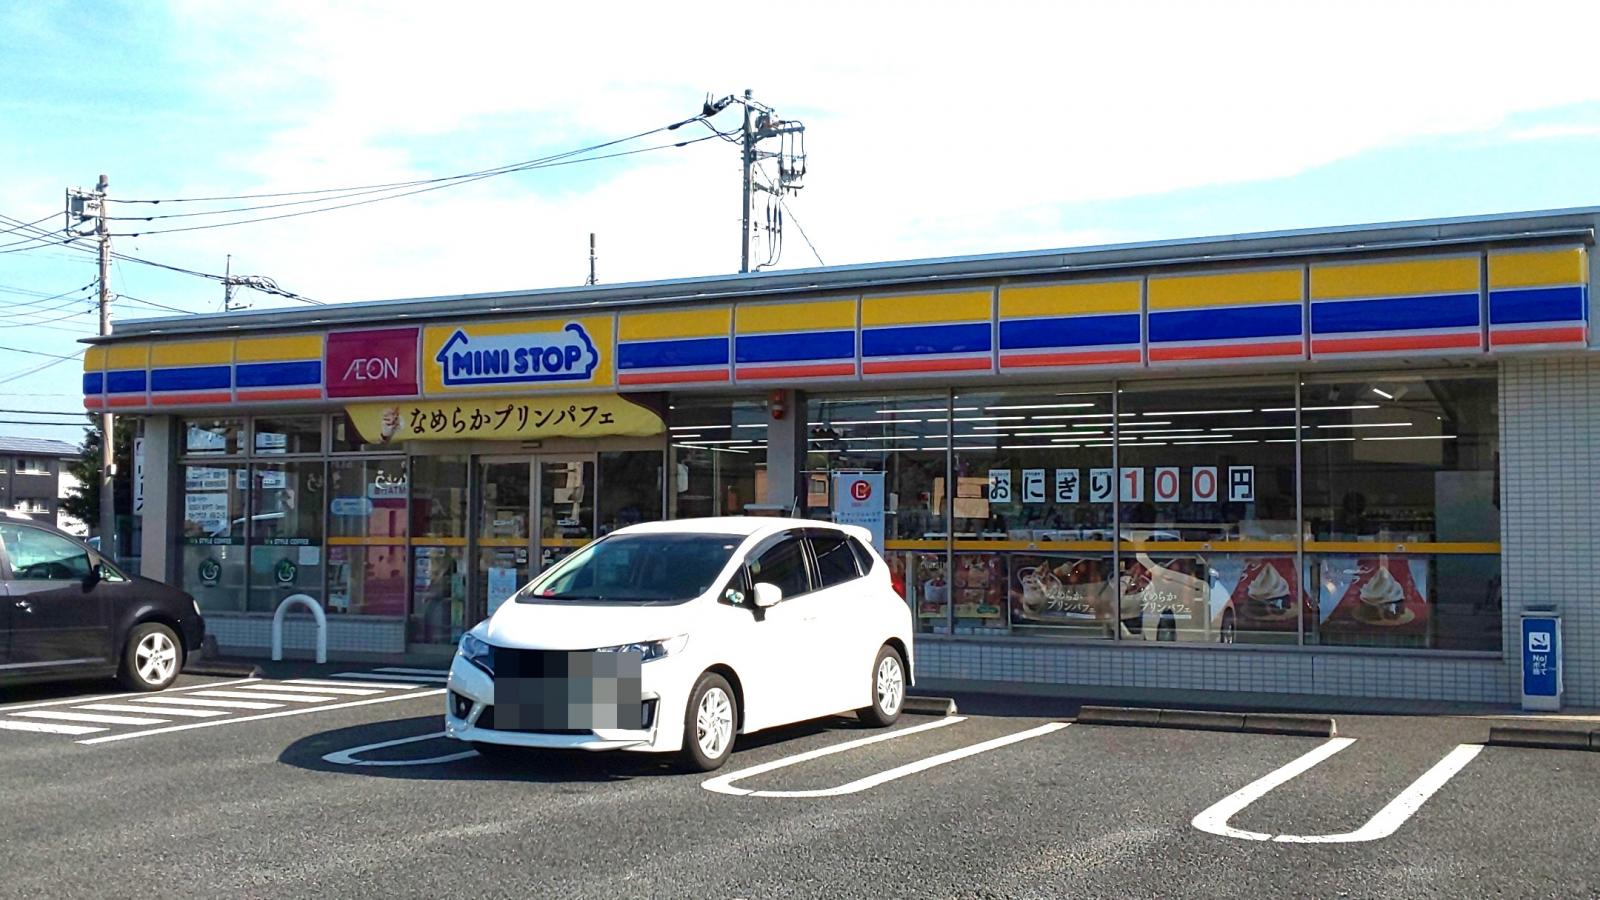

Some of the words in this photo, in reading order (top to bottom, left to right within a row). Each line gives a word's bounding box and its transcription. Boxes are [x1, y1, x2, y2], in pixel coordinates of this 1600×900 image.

[452, 348, 509, 376] MINI
[514, 344, 582, 374] STOP
[410, 404, 616, 434] なめらかプリンパフェ
[991, 470, 1253, 500] おにぎり100円
